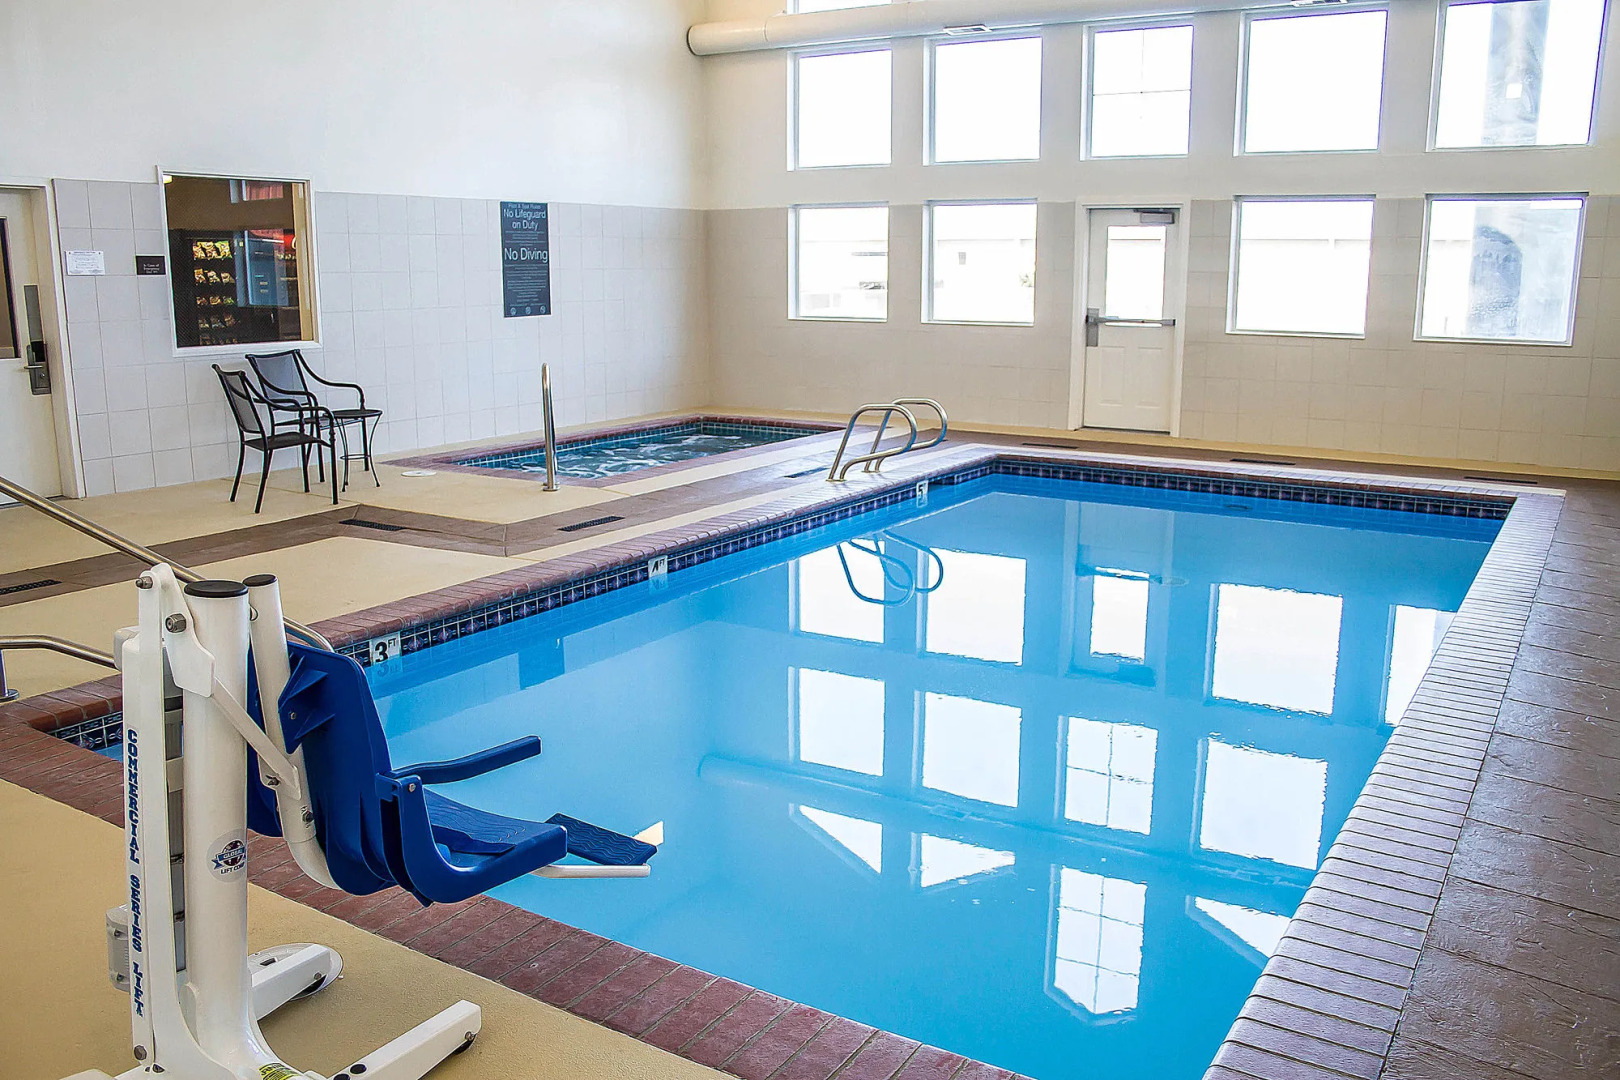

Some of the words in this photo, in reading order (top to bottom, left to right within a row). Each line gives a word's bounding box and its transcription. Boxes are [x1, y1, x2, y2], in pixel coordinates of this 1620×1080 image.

[503, 209, 514, 218] No
[515, 210, 546, 220] Lifeguard
[512, 221, 521, 229] on
[522, 220, 538, 231] Duty
[504, 247, 518, 260] No
[520, 247, 548, 263] Diving
[127, 728, 140, 864] COMMERCIAL
[130, 874, 142, 952] SERIES
[132, 961, 144, 1017] LIFT
